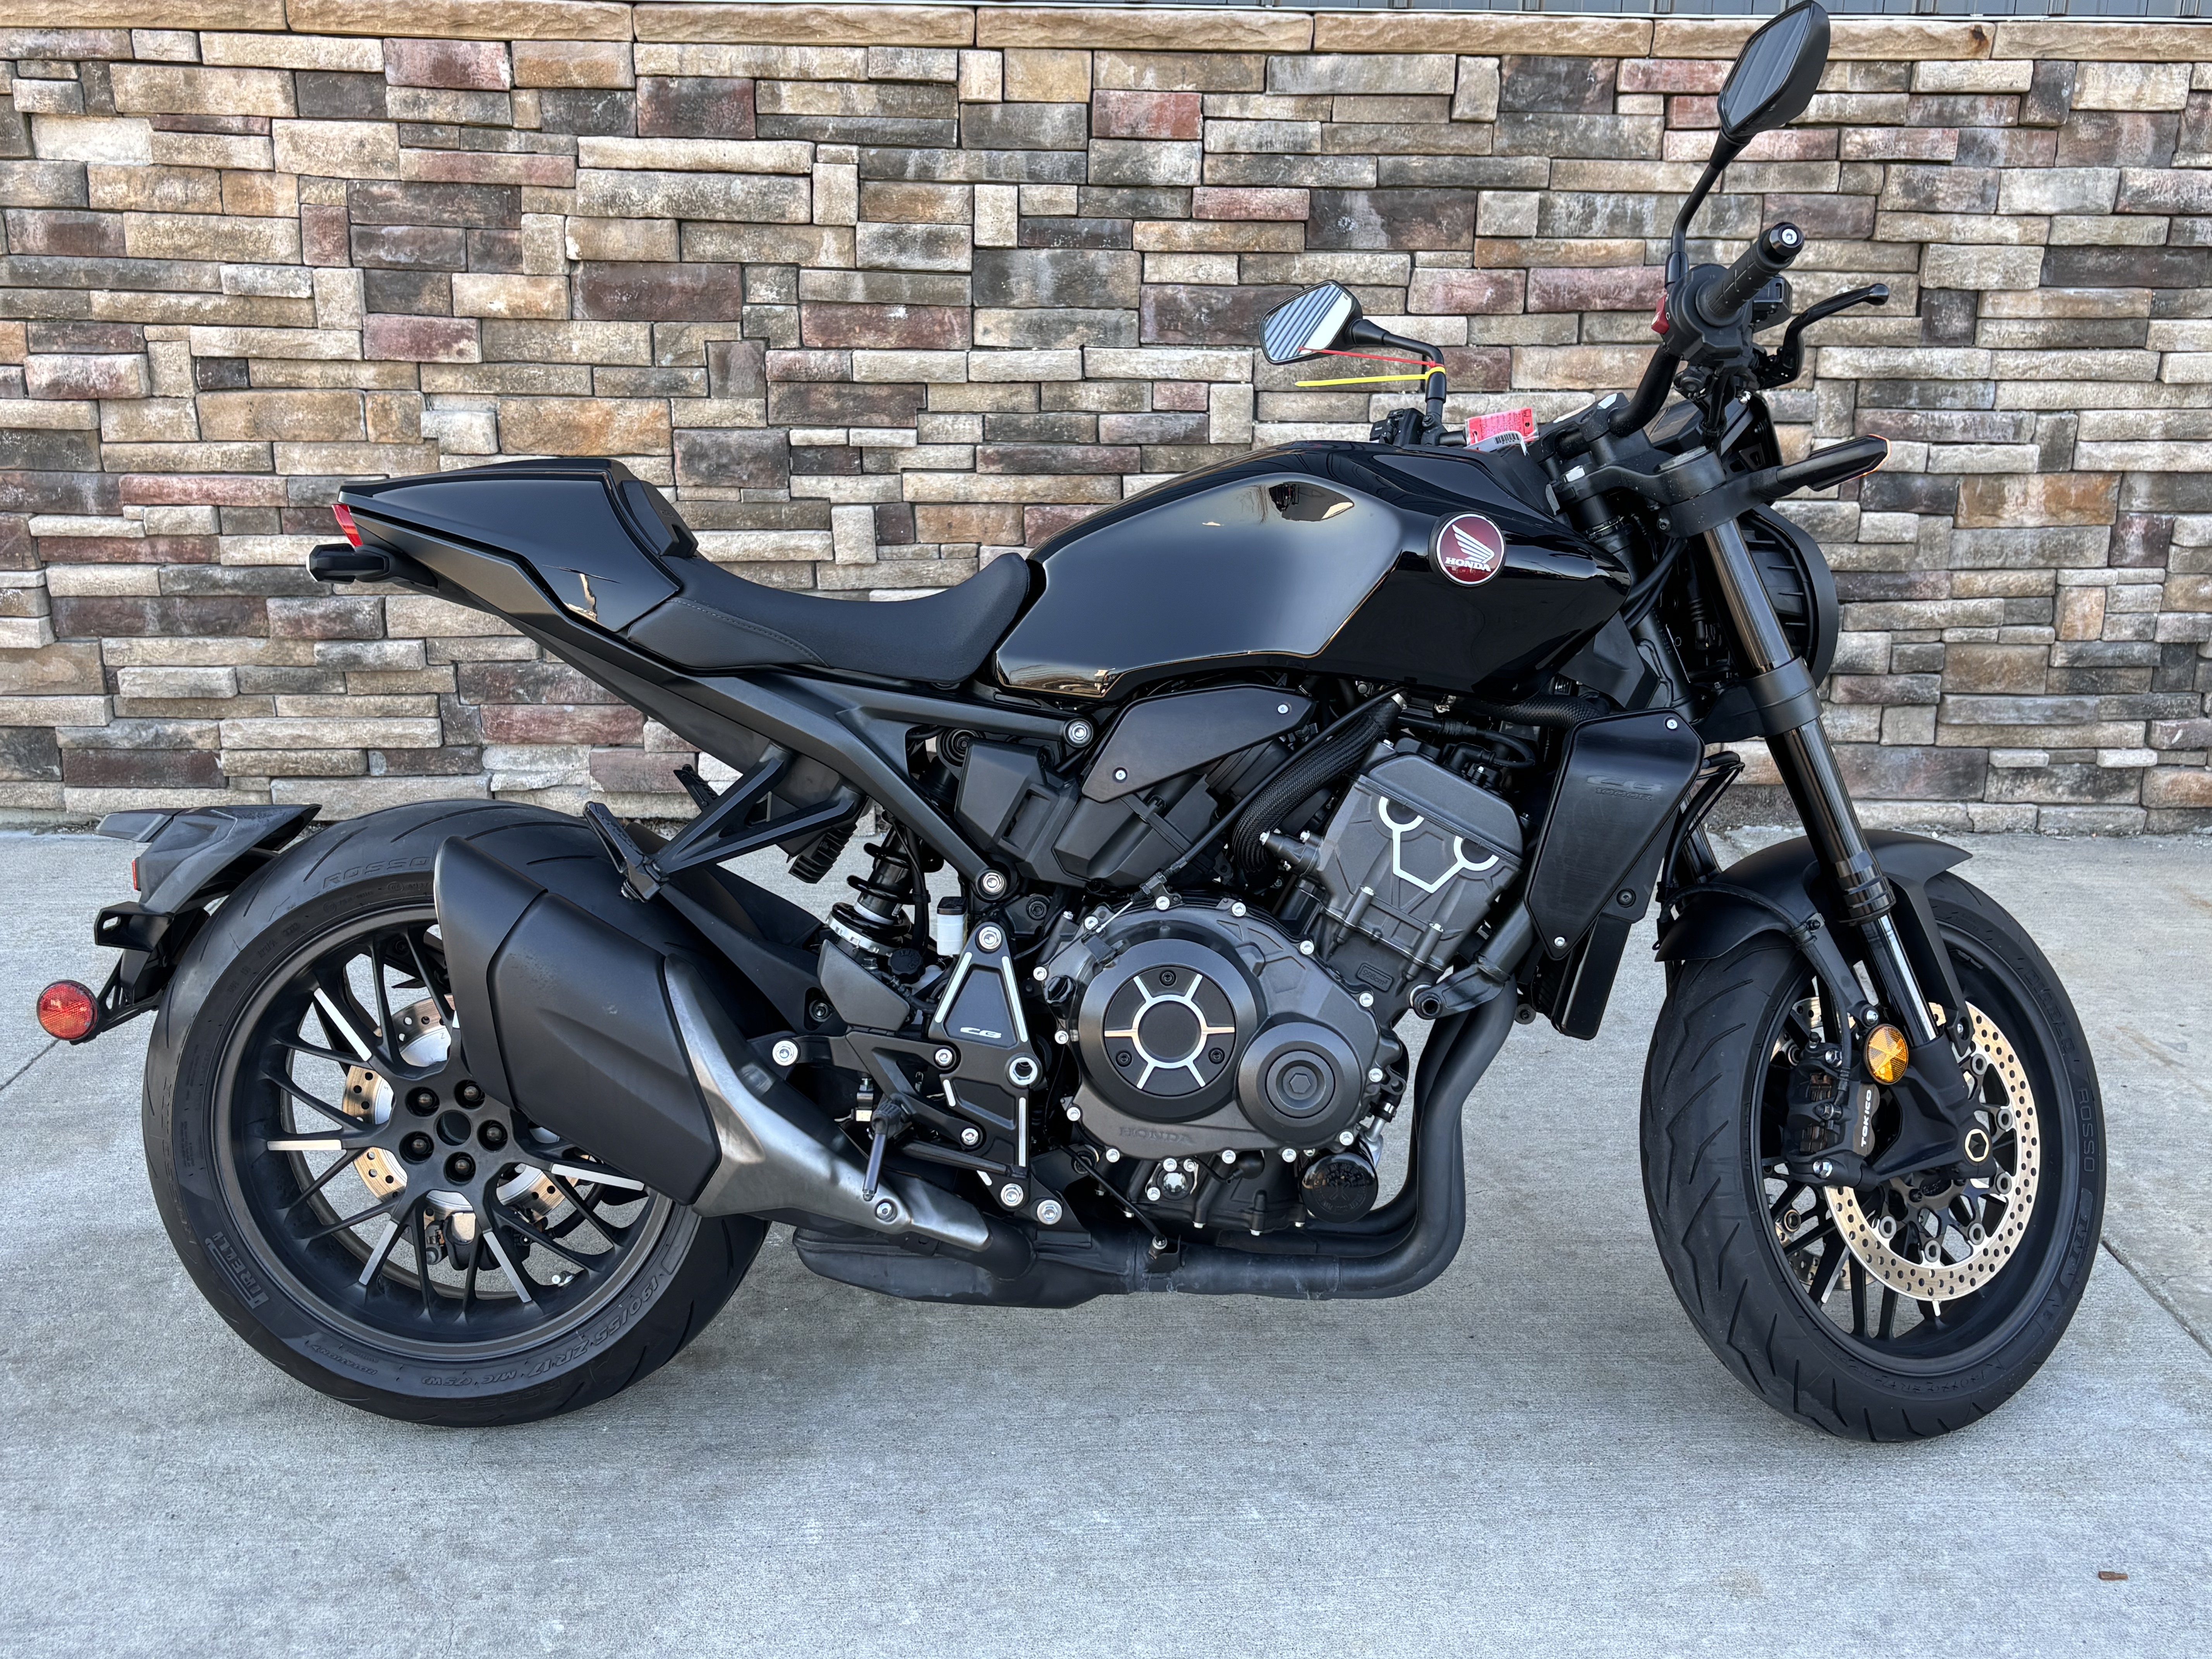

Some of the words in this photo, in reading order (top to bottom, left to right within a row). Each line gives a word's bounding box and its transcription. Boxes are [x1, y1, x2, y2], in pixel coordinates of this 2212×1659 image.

[1445, 556, 1491, 572] HONDA
[1587, 775, 1663, 792] CB
[1595, 787, 1652, 801] 1000R
[323, 857, 431, 888] ROSSO
[2025, 970, 2075, 1054] DIABLO
[960, 1027, 1001, 1038] CB
[1860, 1089, 1872, 1148] TOKICO
[1119, 1126, 1195, 1144] HONDA
[2077, 1087, 2094, 1171] ROSSO
[205, 1231, 269, 1310] PIRELLI
[594, 1278, 661, 1345] 190/55
[319, 1348, 378, 1376] ROTATION
[528, 1361, 552, 1377] 17
[420, 1375, 472, 1386] (75W)
[481, 1370, 518, 1385] M/C
